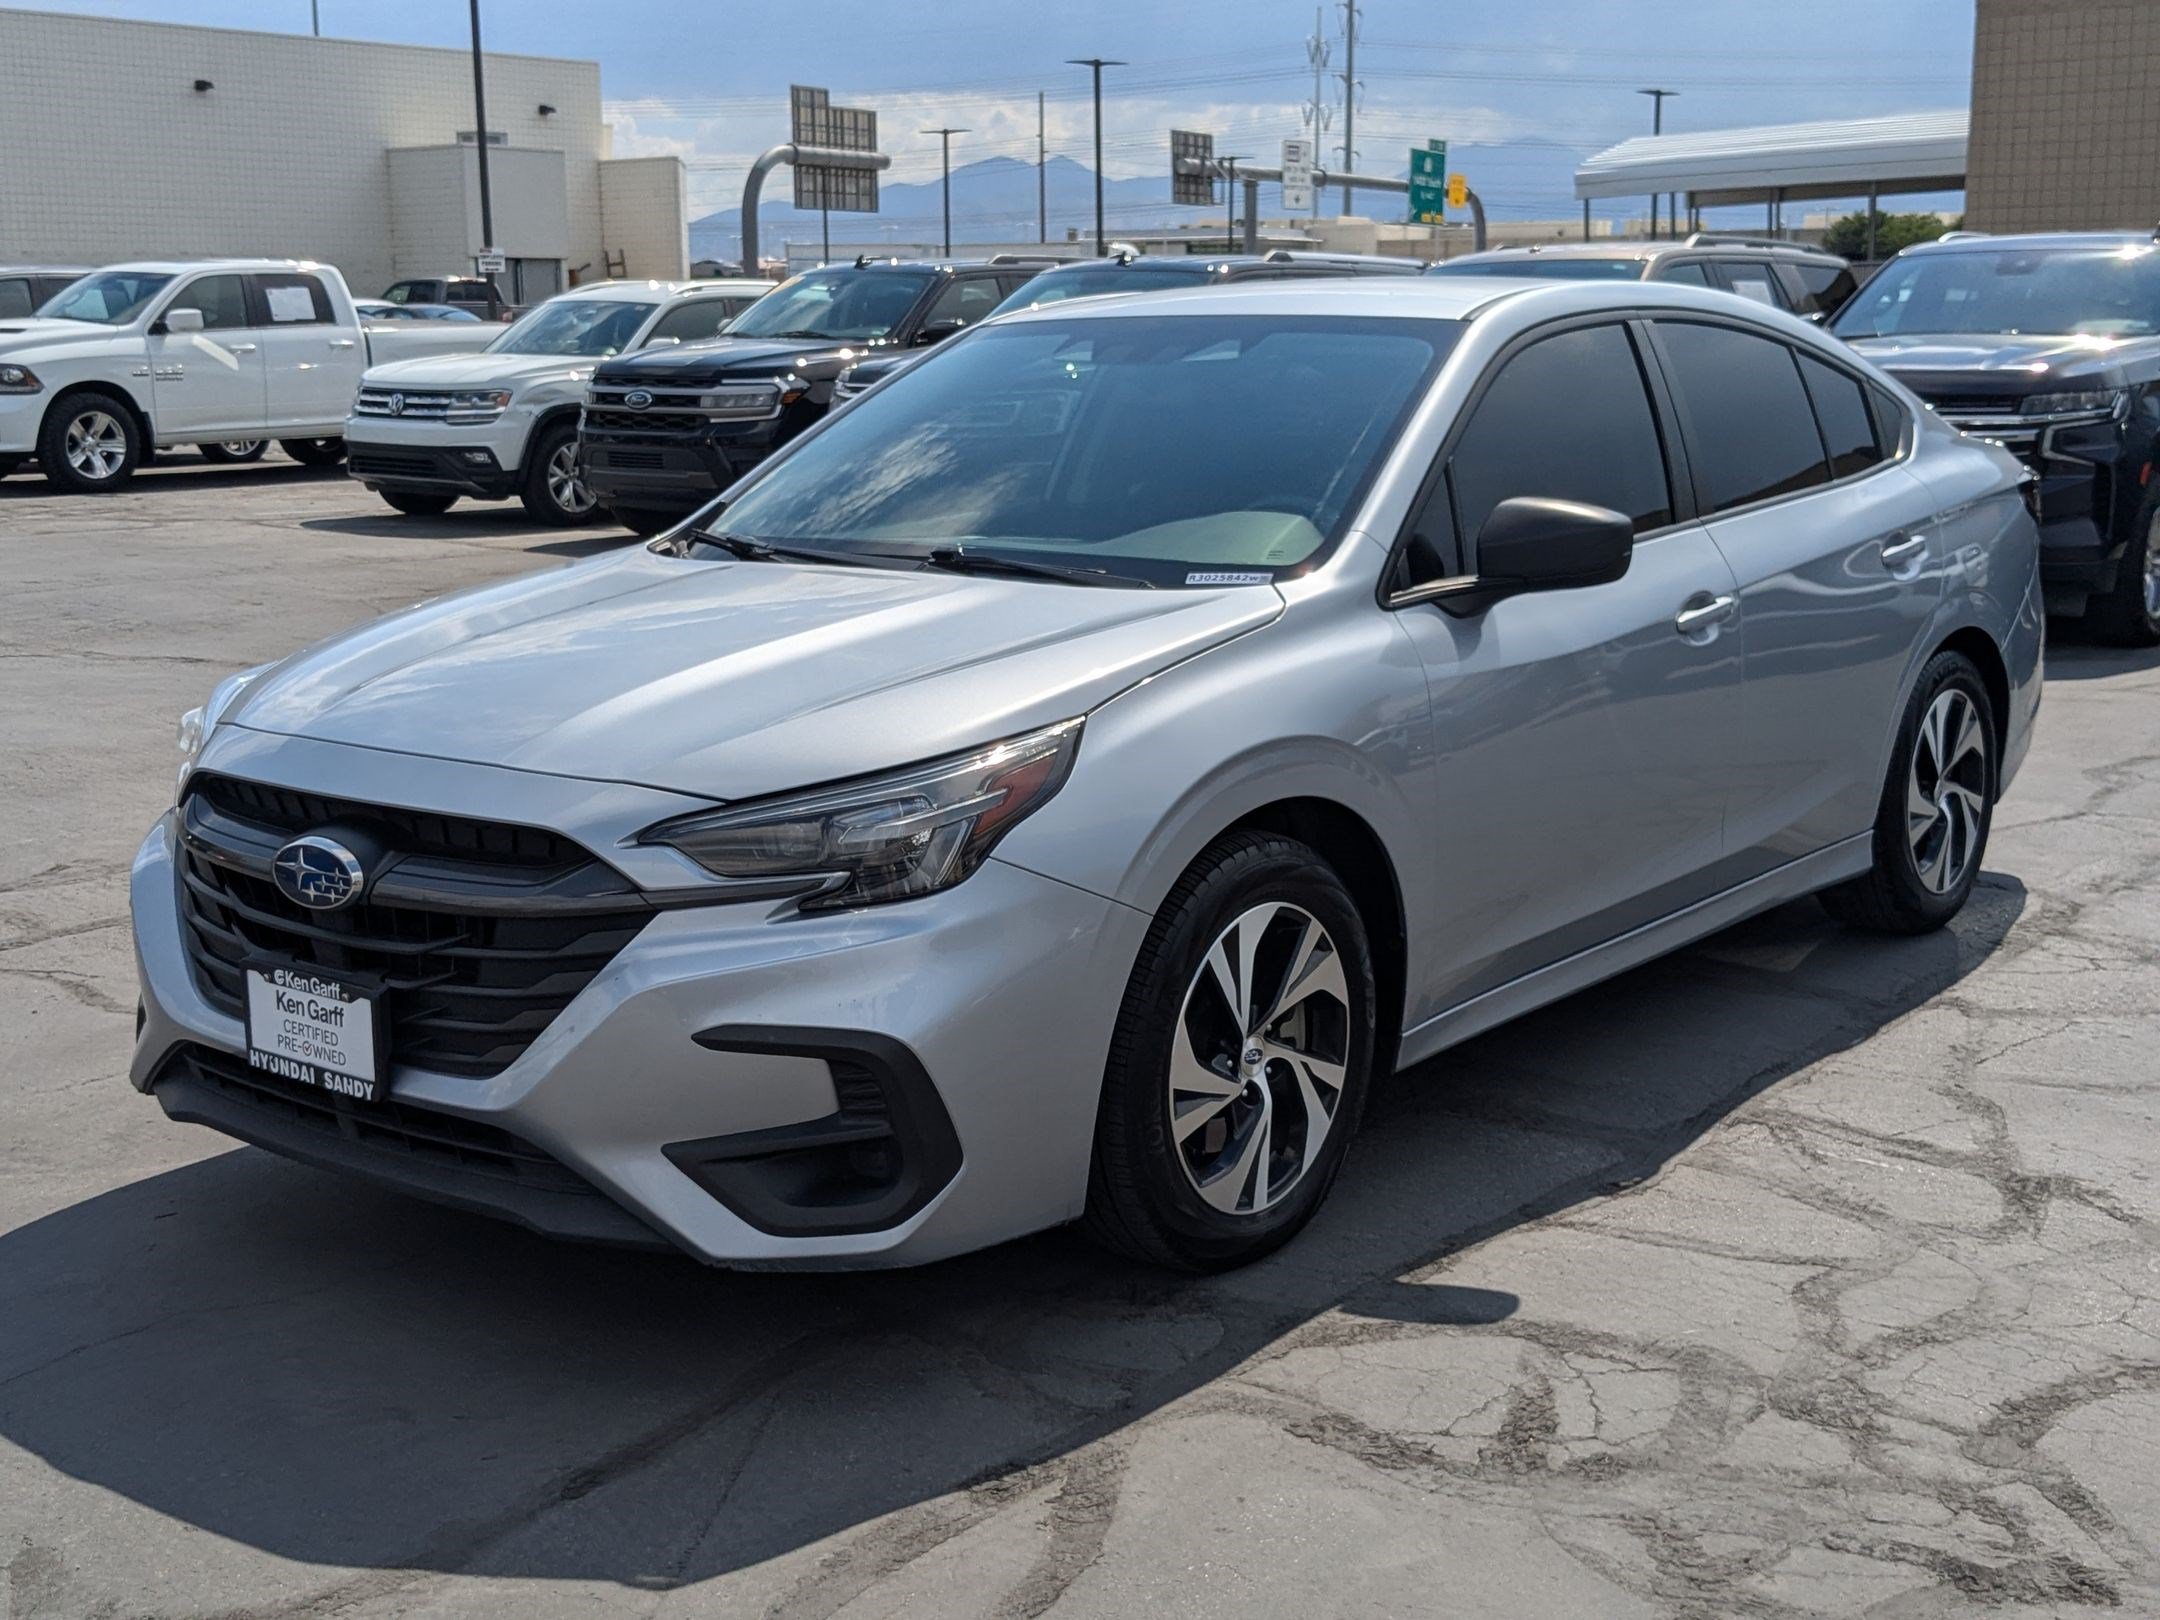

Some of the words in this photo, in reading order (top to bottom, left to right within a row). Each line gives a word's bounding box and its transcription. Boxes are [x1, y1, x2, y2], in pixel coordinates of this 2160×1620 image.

[285, 970, 309, 992] Ken
[310, 977, 340, 1000] Garff
[276, 989, 306, 1017] Ken
[307, 999, 345, 1028] Garff
[283, 1018, 339, 1047] CERTIFIED
[250, 1049, 315, 1084] HYUNDAI
[324, 1071, 374, 1101] SANDY
